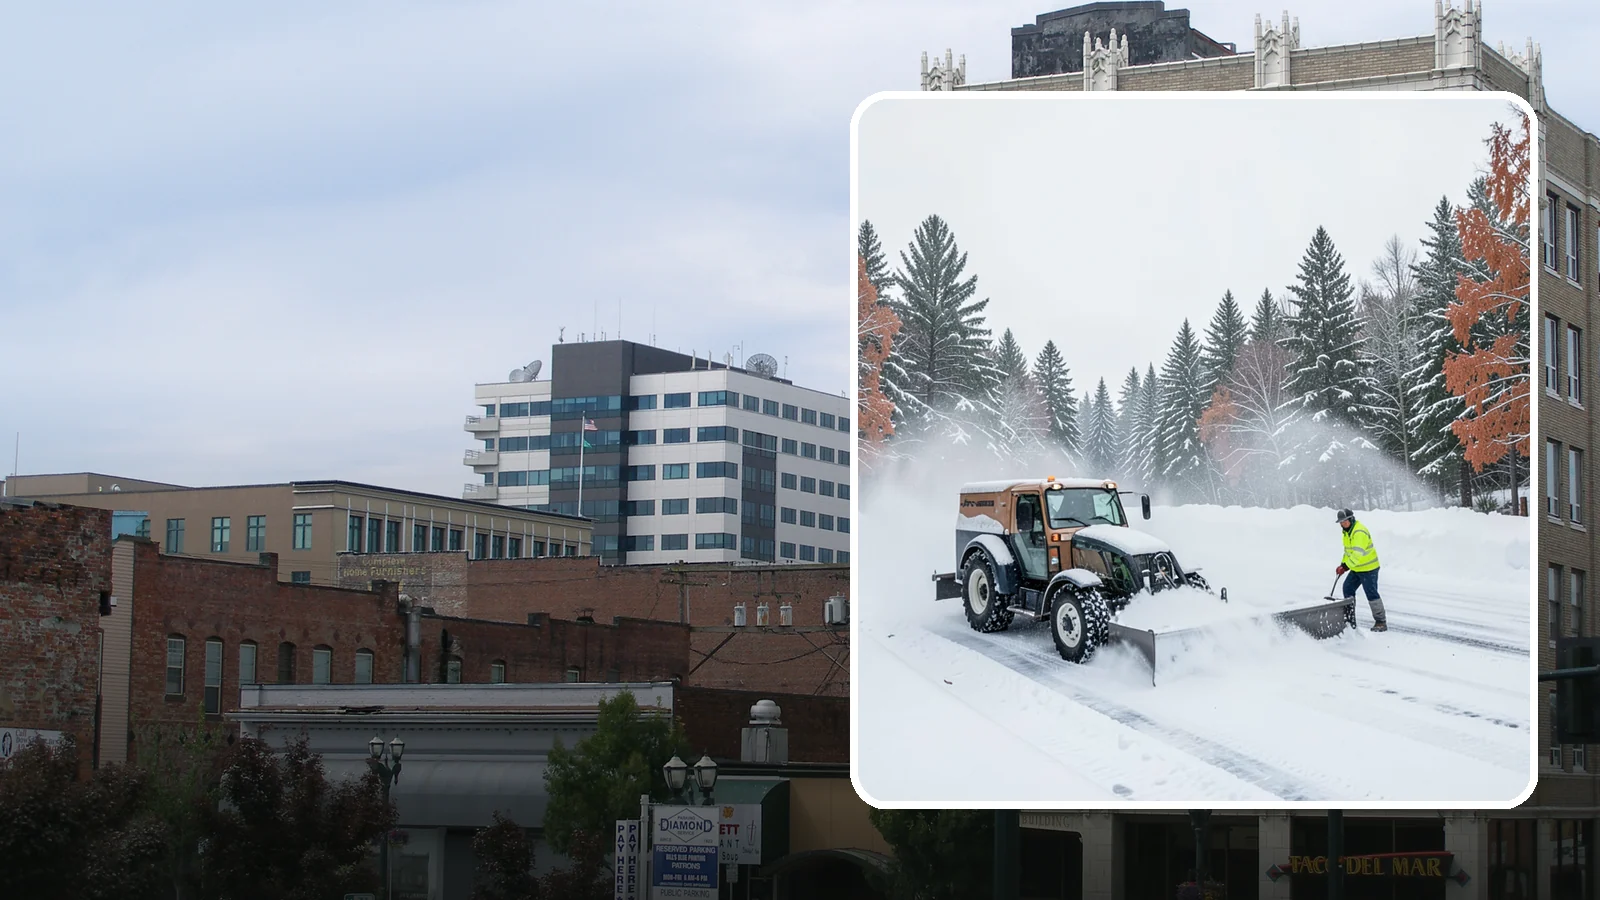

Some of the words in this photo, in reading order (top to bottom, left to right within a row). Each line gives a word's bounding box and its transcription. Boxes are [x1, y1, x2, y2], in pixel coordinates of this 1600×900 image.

[370, 566, 427, 576] Furnishers
[660, 818, 713, 832] DIAMOND
[1022, 815, 1069, 827] BUILDING
[617, 825, 625, 852] PAY
[628, 824, 637, 852] PAY
[655, 845, 688, 853] RESERVED
[689, 846, 716, 854] PARKING
[721, 851, 739, 861] Soup
[1289, 855, 1329, 874] TAC
[1346, 856, 1385, 875] DEL
[1393, 857, 1442, 876] MAR
[616, 856, 625, 893] HERE
[627, 855, 637, 893] HERE
[660, 888, 682, 897] PUBLIC
[683, 889, 710, 898] PARKING
